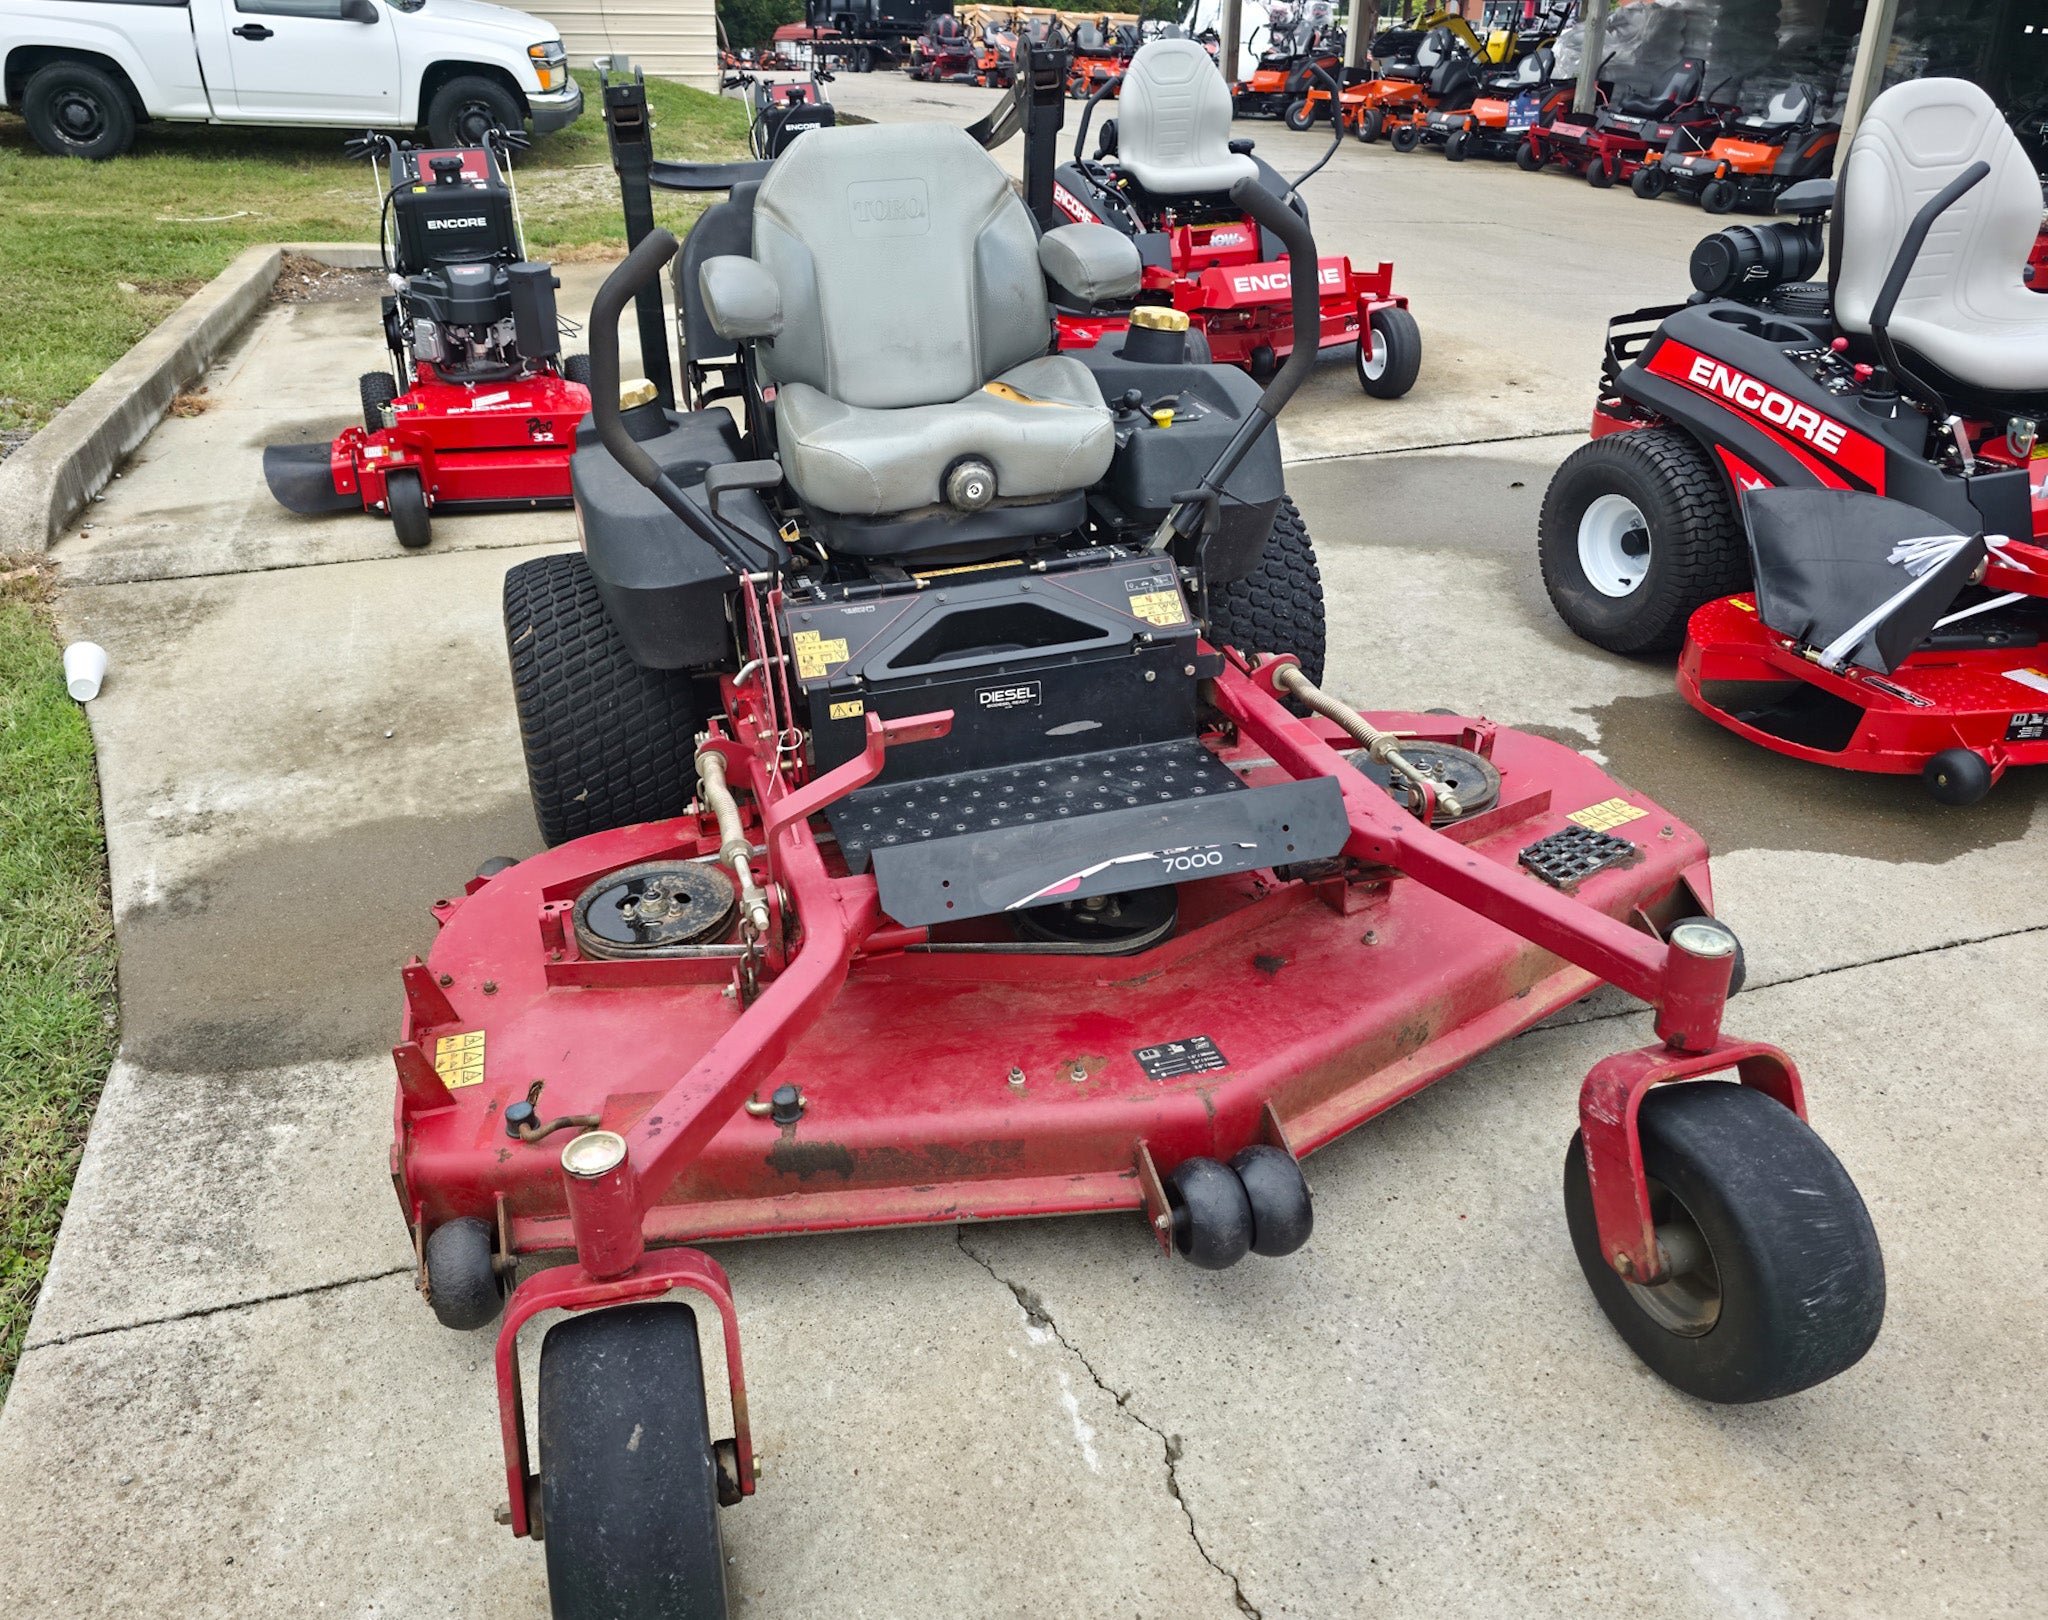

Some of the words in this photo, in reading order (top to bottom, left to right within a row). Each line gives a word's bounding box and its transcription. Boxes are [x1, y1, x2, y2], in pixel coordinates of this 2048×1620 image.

[785, 122, 821, 131] ENCORE
[852, 198, 921, 222] TORO
[427, 217, 487, 230] ENCORE
[1233, 267, 1341, 293] ENCE
[1688, 356, 1847, 455] ENCORE
[533, 432, 554, 442] 32
[980, 687, 1037, 704] DIESEL
[1162, 851, 1223, 872] 7000
